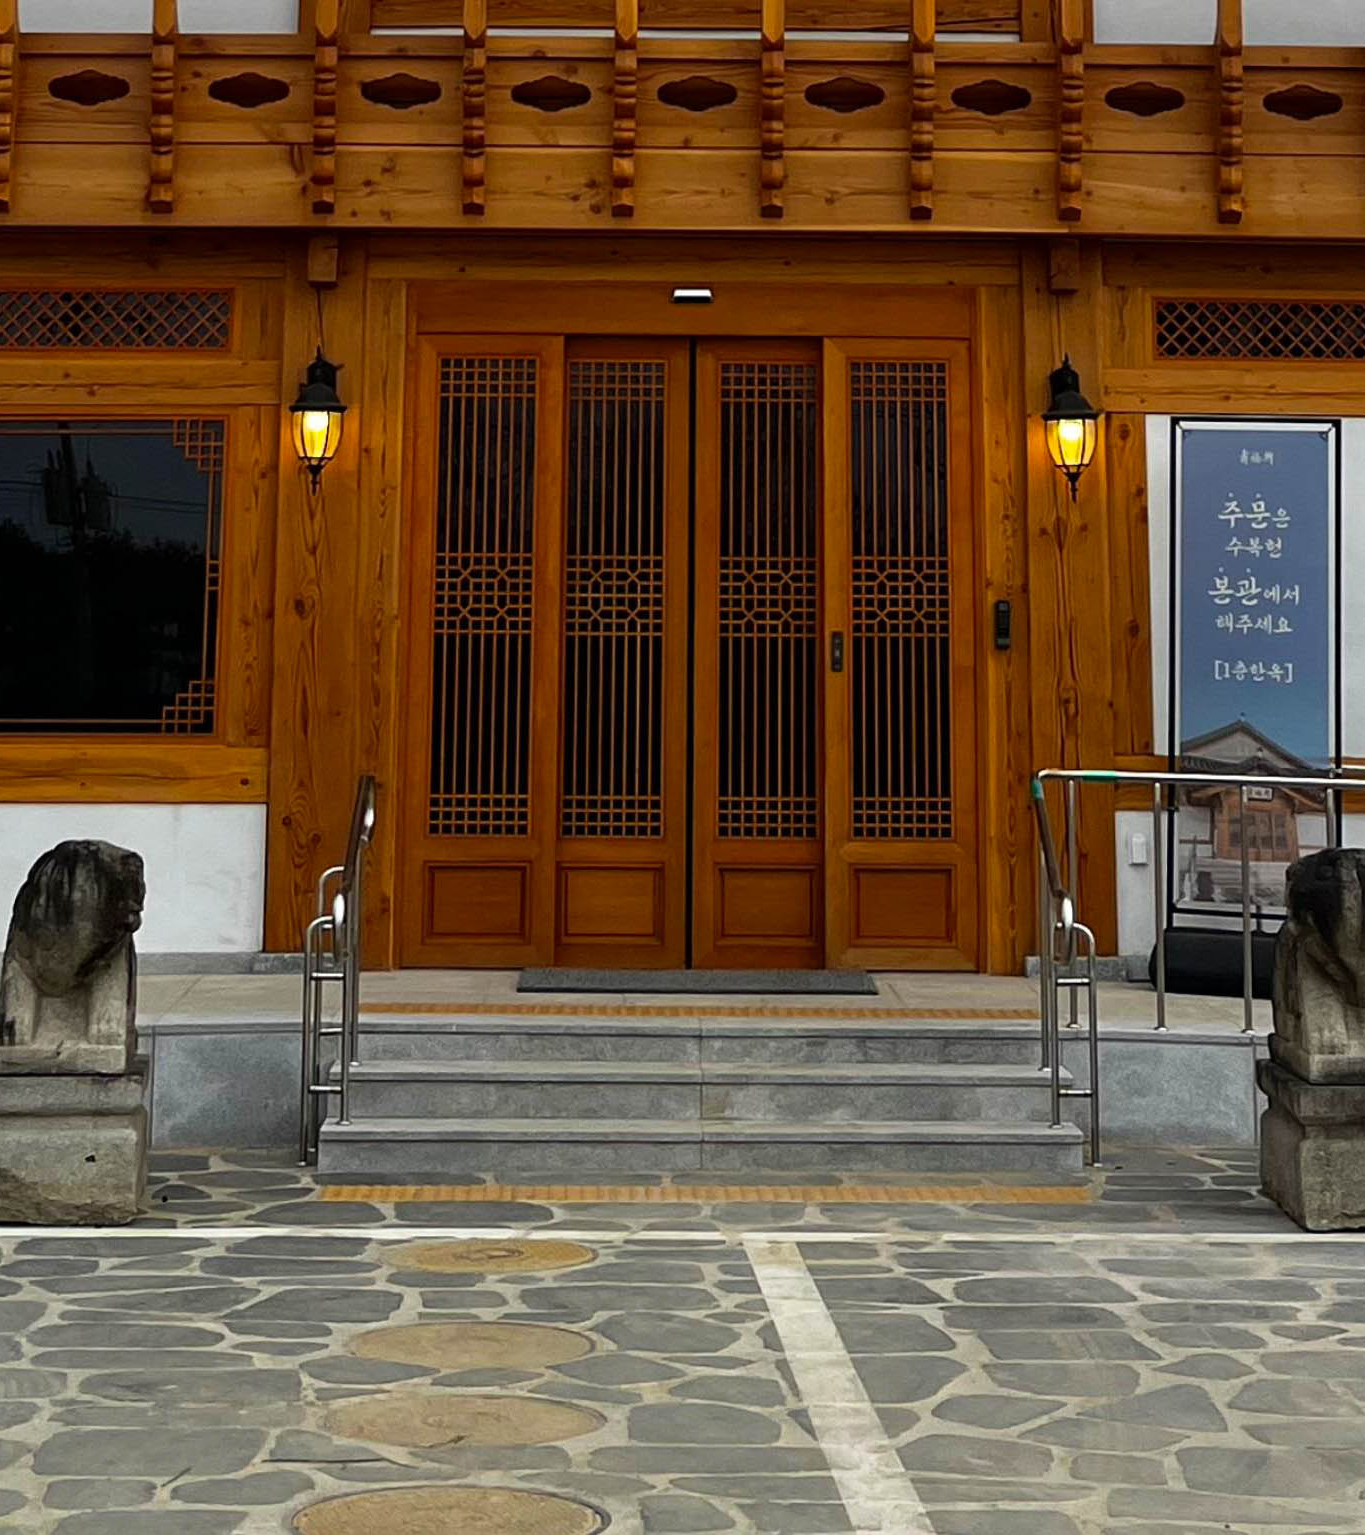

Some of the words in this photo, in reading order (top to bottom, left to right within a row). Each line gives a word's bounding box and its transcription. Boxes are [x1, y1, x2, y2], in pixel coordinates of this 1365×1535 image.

[1217, 498, 1291, 529] 주문은
[1207, 572, 1300, 606] 본관에서
[1215, 612, 1294, 635] 해주세요
